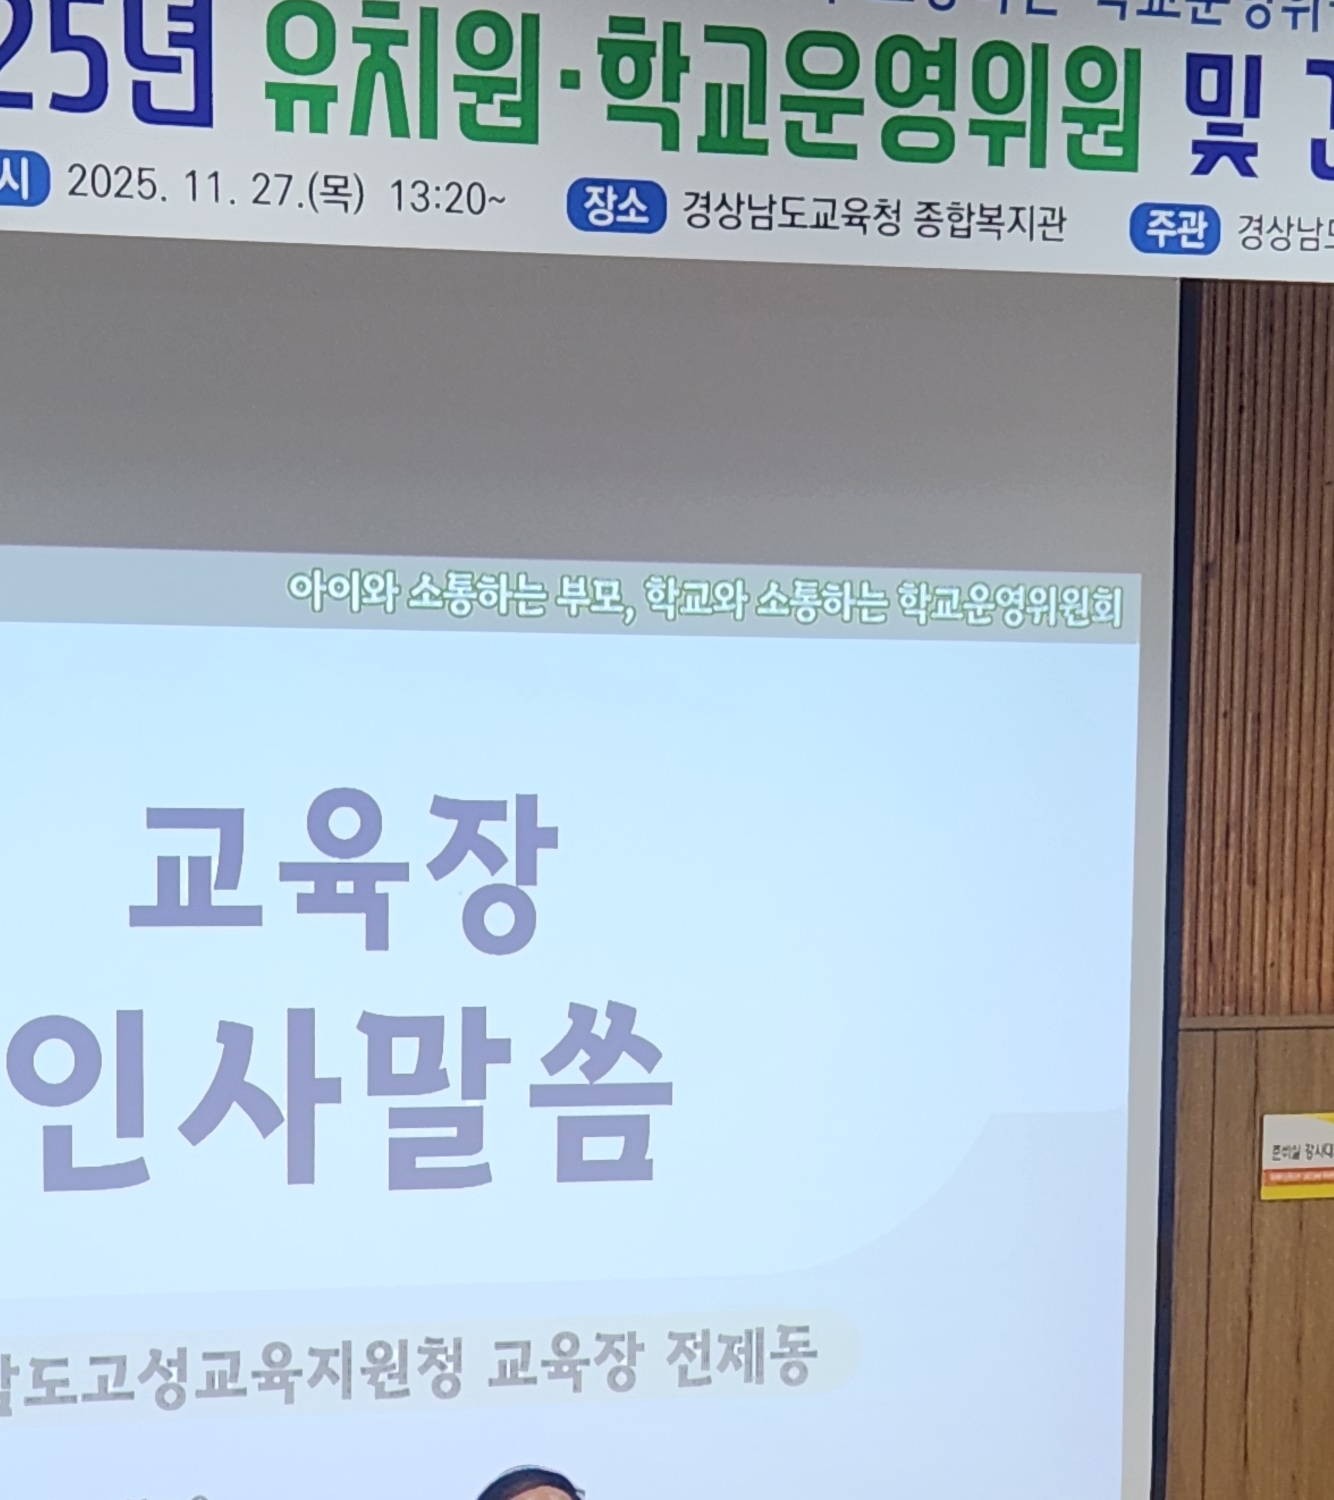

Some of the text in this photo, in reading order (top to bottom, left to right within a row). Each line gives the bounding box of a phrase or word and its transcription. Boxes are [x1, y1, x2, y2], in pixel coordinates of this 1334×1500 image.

[1185, 52, 1262, 178] 및
[67, 163, 167, 203] 2025.
[184, 170, 237, 206] 11.
[251, 171, 365, 215] 27.(목)
[389, 178, 507, 216] 13:20~
[582, 184, 1067, 243] 장소 경상남도교육청 종합복지관
[1146, 209, 1209, 250] 주관
[286, 569, 1123, 629] 아이와 소통하는 부모, 학교와 소통하는 학교운영위원회
[129, 787, 559, 956] 교육장
[6, 1000, 674, 1192] 인사말씀
[487, 1329, 646, 1394] 교육장
[666, 1324, 819, 1388] 전제동
